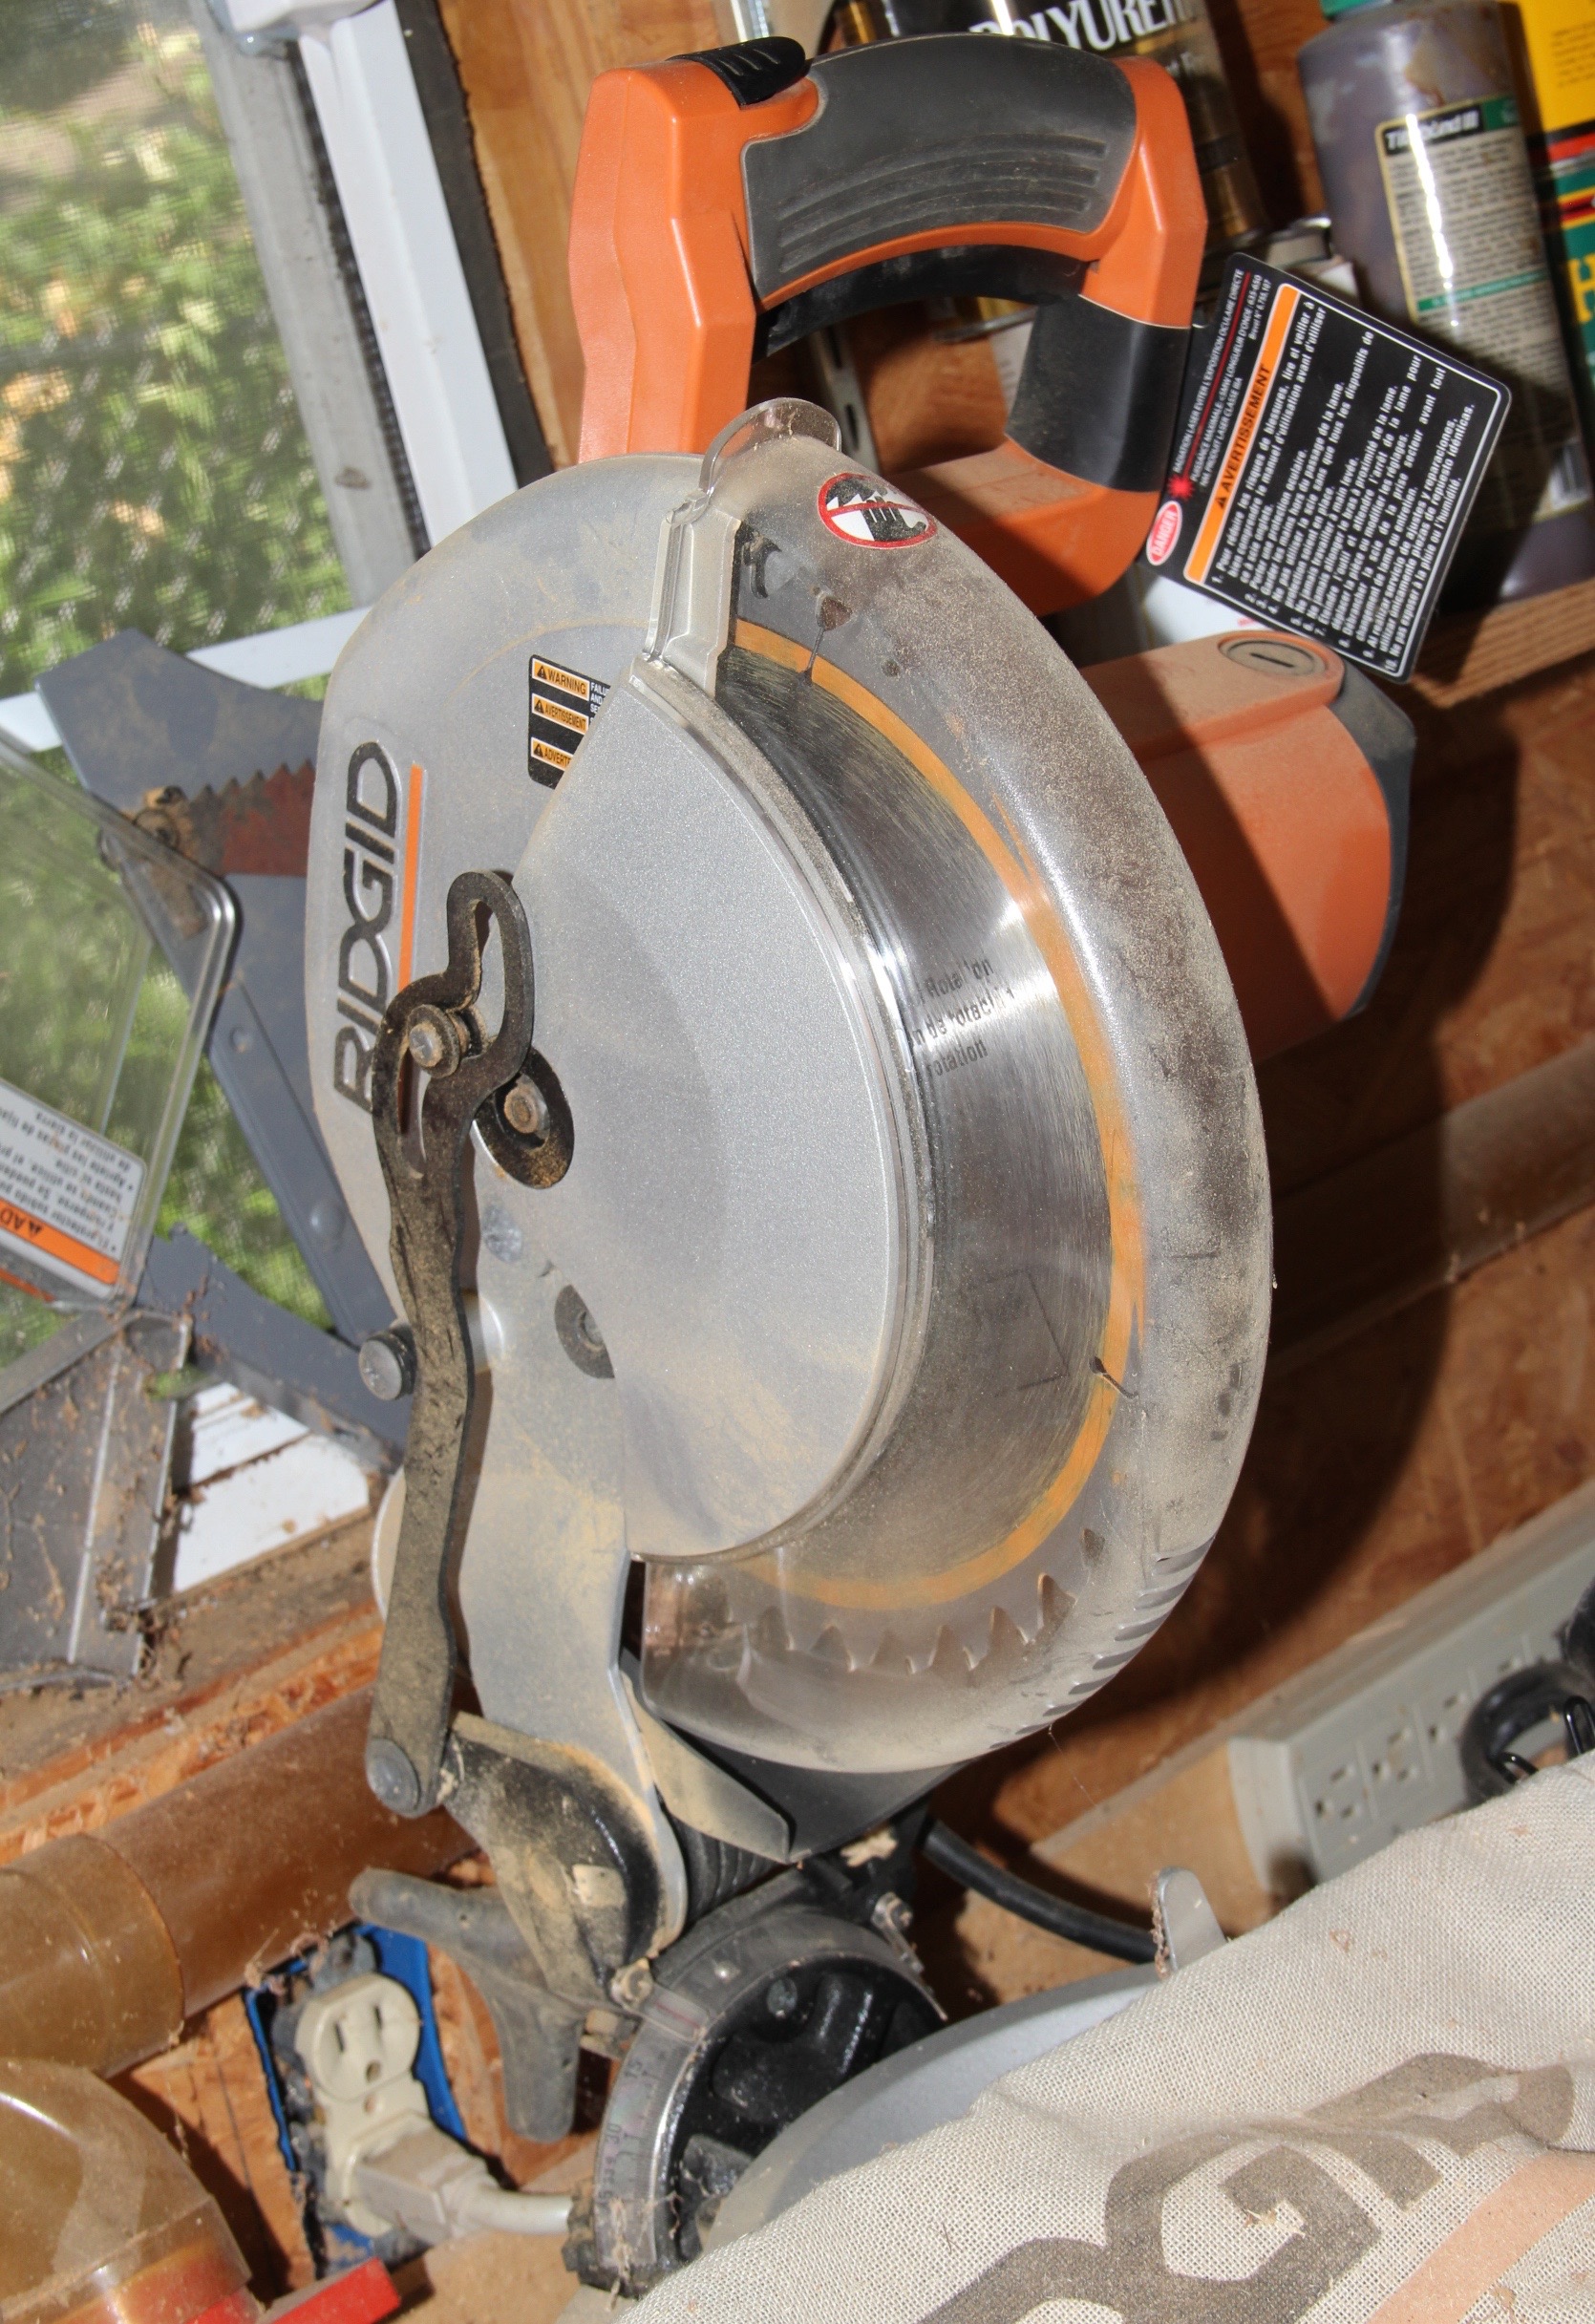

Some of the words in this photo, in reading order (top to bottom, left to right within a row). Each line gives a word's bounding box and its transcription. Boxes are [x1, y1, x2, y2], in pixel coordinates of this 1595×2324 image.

[1304, 300, 1315, 309] à
[1291, 310, 1311, 346] veiller
[1303, 306, 1328, 353] d'utiliser
[1361, 330, 1374, 346] de
[1184, 408, 1200, 434] LASER
[1192, 383, 1207, 411] EVITER
[1216, 298, 1235, 336] OCULAIRE
[1227, 267, 1244, 300] DIRECTE
[1287, 346, 1300, 359] et
[1189, 440, 1209, 482] PUISSANCE
[1223, 334, 1244, 377] LONGUEUR
[1236, 307, 1252, 336] D'ONDE
[1245, 273, 1263, 306] 635-650
[1280, 359, 1295, 379] lire
[1293, 352, 1311, 383] avant
[1342, 346, 1371, 400] dispositifs
[1407, 354, 1424, 382] pour
[1429, 365, 1446, 390] tout
[1325, 378, 1345, 410] lame.
[1379, 382, 1398, 413] lame.
[1393, 383, 1412, 412] lame
[1272, 382, 1302, 444] d'utilisation
[1321, 408, 1334, 421] la
[1335, 399, 1350, 418] les
[1374, 412, 1387, 425] la
[1416, 393, 1436, 425] avant
[1203, 438, 1222, 473] PRODUIT
[1214, 415, 1229, 440] LASER
[1222, 387, 1238, 416] CLASSE
[1220, 363, 1271, 492] AVERTISSEMENT
[1315, 420, 1329, 437] de
[1327, 418, 1344, 443] tous
[1370, 424, 1383, 440] de
[1388, 416, 1400, 429] la
[1446, 400, 1475, 458] idénticas.
[1256, 435, 1270, 451] de
[1381, 432, 1394, 447] de
[1401, 427, 1424, 468] secteur
[1259, 443, 1281, 483] manuel
[1303, 436, 1327, 479] passage
[1321, 444, 1336, 466] que
[1352, 438, 1379, 489] proximité
[1368, 450, 1388, 484] l'arrêt
[1384, 431, 1411, 479] réglages.
[1421, 415, 1459, 492] reparaciones,
[1243, 451, 1266, 491] risques
[1284, 446, 1308, 492] oculaire.
[1311, 466, 1328, 492] sans
[1339, 454, 1358, 486] levée.
[1429, 457, 1457, 506] repuesto
[1254, 483, 1267, 497] le
[1295, 476, 1310, 493] du
[1350, 486, 1361, 497] à
[1378, 477, 1393, 495] les
[1390, 471, 1411, 501] prise
[1420, 491, 1432, 501] y
[1236, 490, 1251, 509] les
[1287, 490, 1305, 516] hors
[1301, 491, 1318, 516] scie
[1316, 482, 1336, 516] place.
[1329, 485, 1348, 513] main
[1341, 495, 1358, 520] bras
[1350, 487, 1374, 531] attendre
[1384, 502, 1397, 516] la
[1393, 483, 1418, 533] entretien.
[1434, 474, 1461, 529] l'humidité.
[1234, 496, 1265, 557] comprendre
[1252, 501, 1276, 543] onglets.
[1265, 490, 1294, 543] protection
[1296, 515, 1309, 529] la
[1312, 515, 1324, 530] en
[1327, 511, 1338, 522] à
[1337, 519, 1350, 531] le
[1363, 495, 1386, 538] modifier
[1404, 499, 1429, 542] ajustes
[1423, 505, 1437, 522] de
[1151, 507, 1178, 558] DANGER
[1223, 509, 1244, 546] réduire
[1276, 514, 1297, 547] mains
[1345, 534, 1358, 547] et
[1377, 519, 1392, 536] de
[1390, 533, 1401, 547] ou
[1411, 521, 1434, 559] piezas
[1431, 529, 1442, 544] ou
[1245, 540, 1261, 563] scie
[1261, 540, 1274, 560] une
[1270, 544, 1287, 564] les
[1284, 528, 1305, 566] utiliser
[1300, 528, 1319, 562] soient
[1310, 520, 1335, 566] travailler
[1322, 529, 1348, 574] allonger
[1359, 538, 1371, 552] ou
[1368, 539, 1385, 563] scie
[1398, 539, 1413, 556] de
[1215, 545, 1233, 572] Pour
[1226, 553, 1244, 578] bien
[1243, 561, 1254, 571] à
[1332, 549, 1352, 582] l'outil
[1348, 551, 1368, 581] pièce
[1377, 546, 1396, 573] lame
[1419, 543, 1439, 571] pluie
[1210, 570, 1224, 585] 1.
[1248, 558, 1267, 590] Porter
[1259, 561, 1281, 596] Garder
[1279, 566, 1294, 587] pas
[1283, 559, 1309, 608] protection
[1299, 565, 1321, 600] jamais
[1344, 578, 1356, 591] la
[1362, 565, 1375, 579] la
[1372, 572, 1387, 587] de
[1383, 555, 1407, 599] servicio
[1413, 580, 1424, 590] à
[1415, 568, 1428, 582] la
[1244, 589, 1257, 603] 2.
[1270, 586, 1286, 603] Ne
[1310, 570, 1332, 606] jamais
[1255, 595, 1268, 609] 3.
[1266, 602, 1280, 615] 4.
[1294, 597, 1308, 613] Ne
[1306, 604, 1320, 619] Ne
[1329, 589, 1353, 631] déplacer
[1341, 581, 1370, 636] Débrancher
[1352, 585, 1384, 643] changement
[1401, 589, 1423, 628] exposer
[1370, 596, 1393, 636] realizar
[1313, 624, 1326, 636] 7.
[1366, 634, 1379, 648] Al
[1377, 616, 1397, 652] utilizar
[1395, 626, 1410, 645] pas
[1389, 641, 1402, 657] Ne
[548, 670, 586, 694] WARNING
[545, 705, 586, 731] AVERTISSEMENT
[333, 740, 401, 1114] RIDGID
[927, 1037, 989, 1077] rotation
